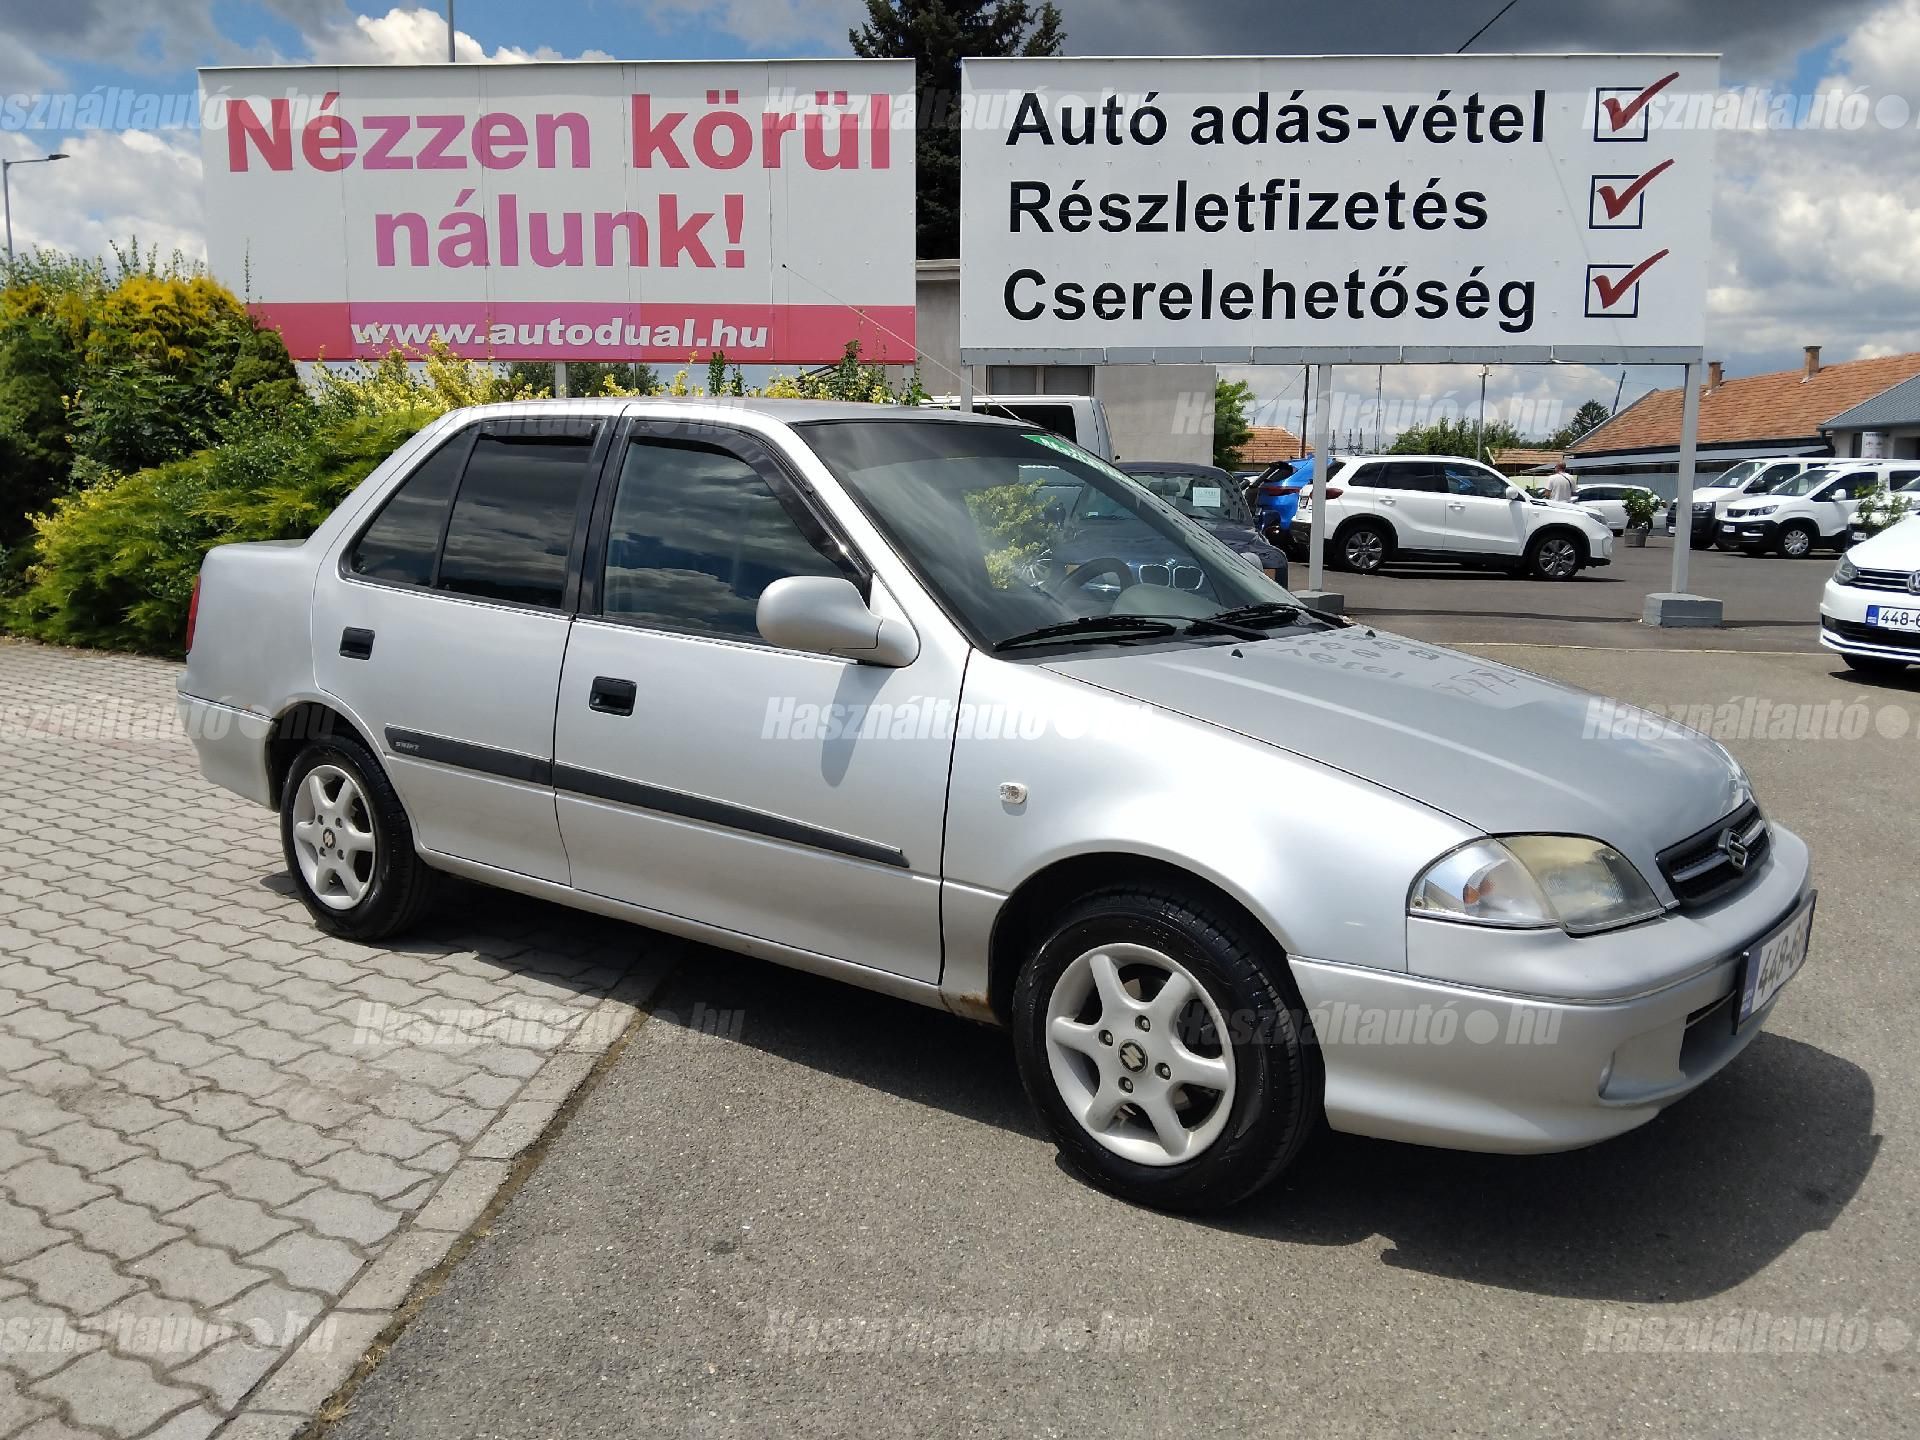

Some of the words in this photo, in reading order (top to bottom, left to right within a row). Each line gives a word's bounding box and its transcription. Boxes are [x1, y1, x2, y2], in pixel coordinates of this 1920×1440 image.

[226, 91, 590, 172] Nézzen
[632, 90, 890, 170] körül
[1006, 91, 1168, 146] Autó
[1191, 90, 1545, 146] adás-vétel
[376, 188, 745, 269] nálunk!
[1010, 177, 1488, 233] Részletfizetés
[1004, 266, 1535, 333] Cserelehetőség
[351, 318, 767, 348] www.autodual.hu
